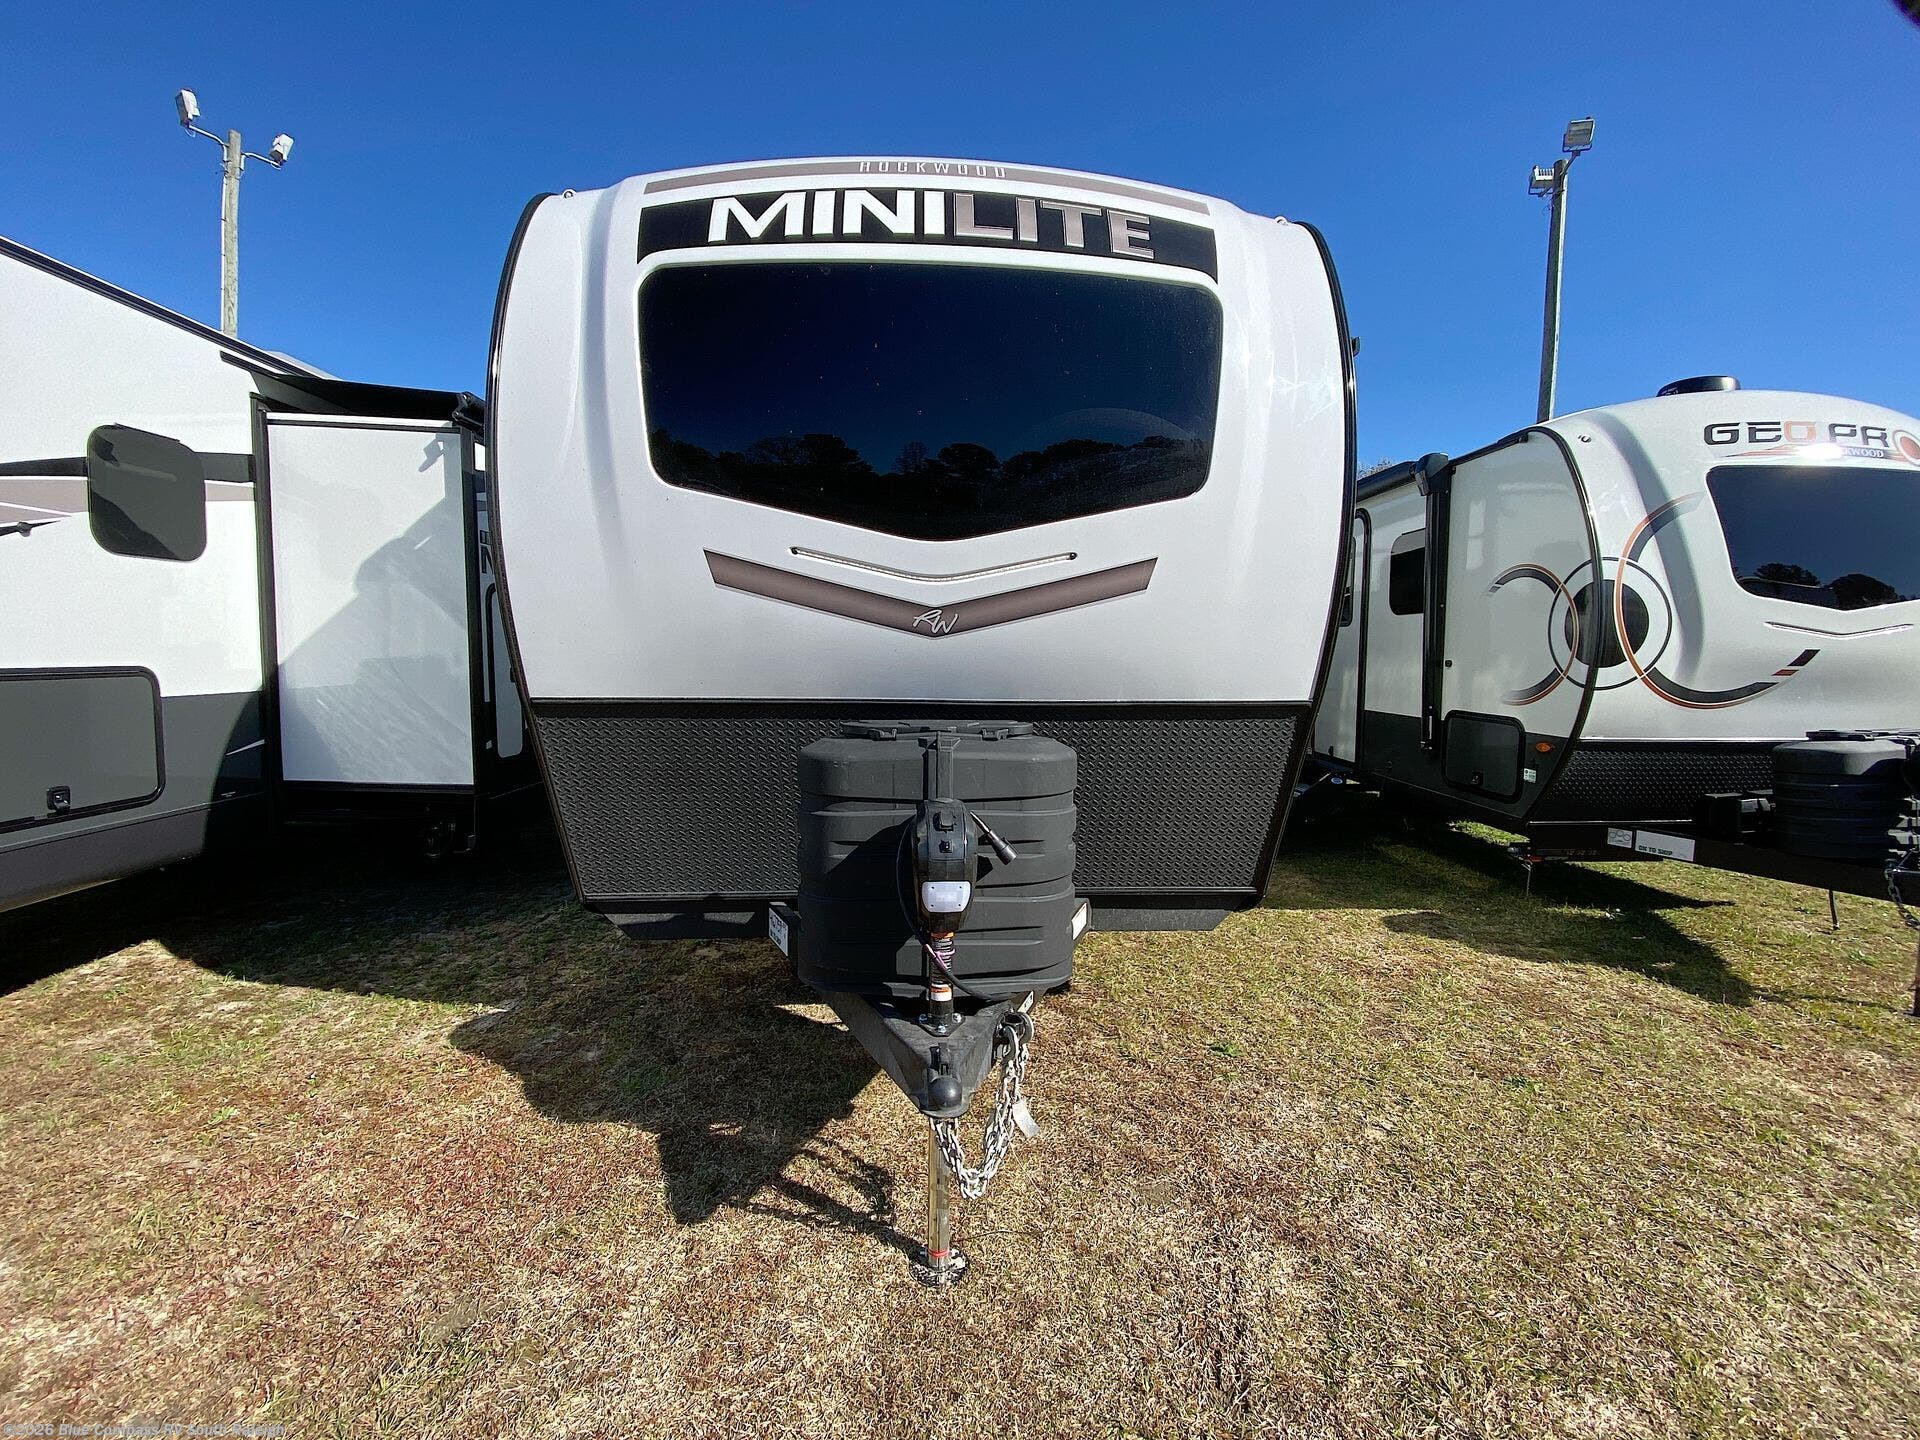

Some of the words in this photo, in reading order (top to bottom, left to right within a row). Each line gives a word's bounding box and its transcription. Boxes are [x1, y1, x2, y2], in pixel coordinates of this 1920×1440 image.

[707, 189, 1155, 259] MINILITE
[1704, 421, 1816, 445] GEO
[912, 609, 959, 634] RW
